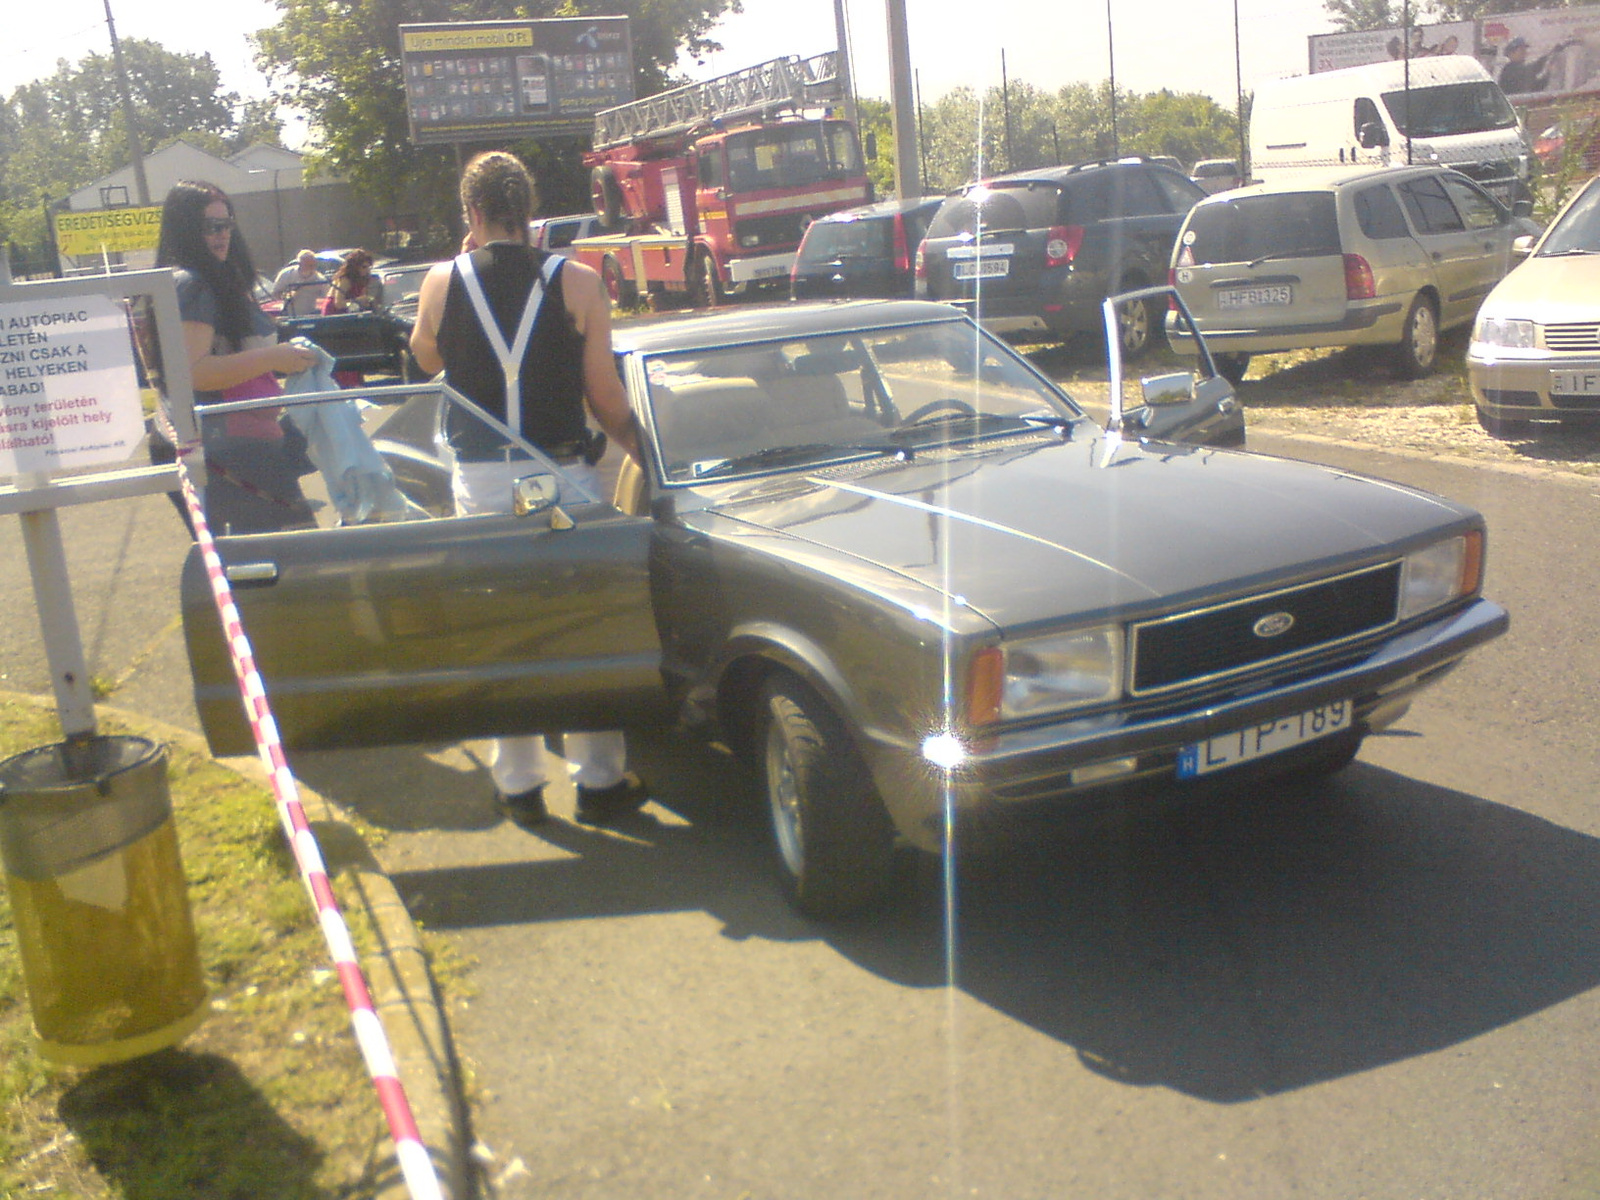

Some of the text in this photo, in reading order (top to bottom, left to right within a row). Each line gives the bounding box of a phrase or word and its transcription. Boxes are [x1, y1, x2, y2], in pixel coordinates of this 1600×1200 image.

[9, 311, 88, 328] AUTÓPIAC
[30, 345, 73, 361] CSAK
[76, 344, 88, 355] A
[6, 361, 88, 379] HELYEKEN
[35, 397, 98, 413] területén
[83, 411, 113, 423] hely
